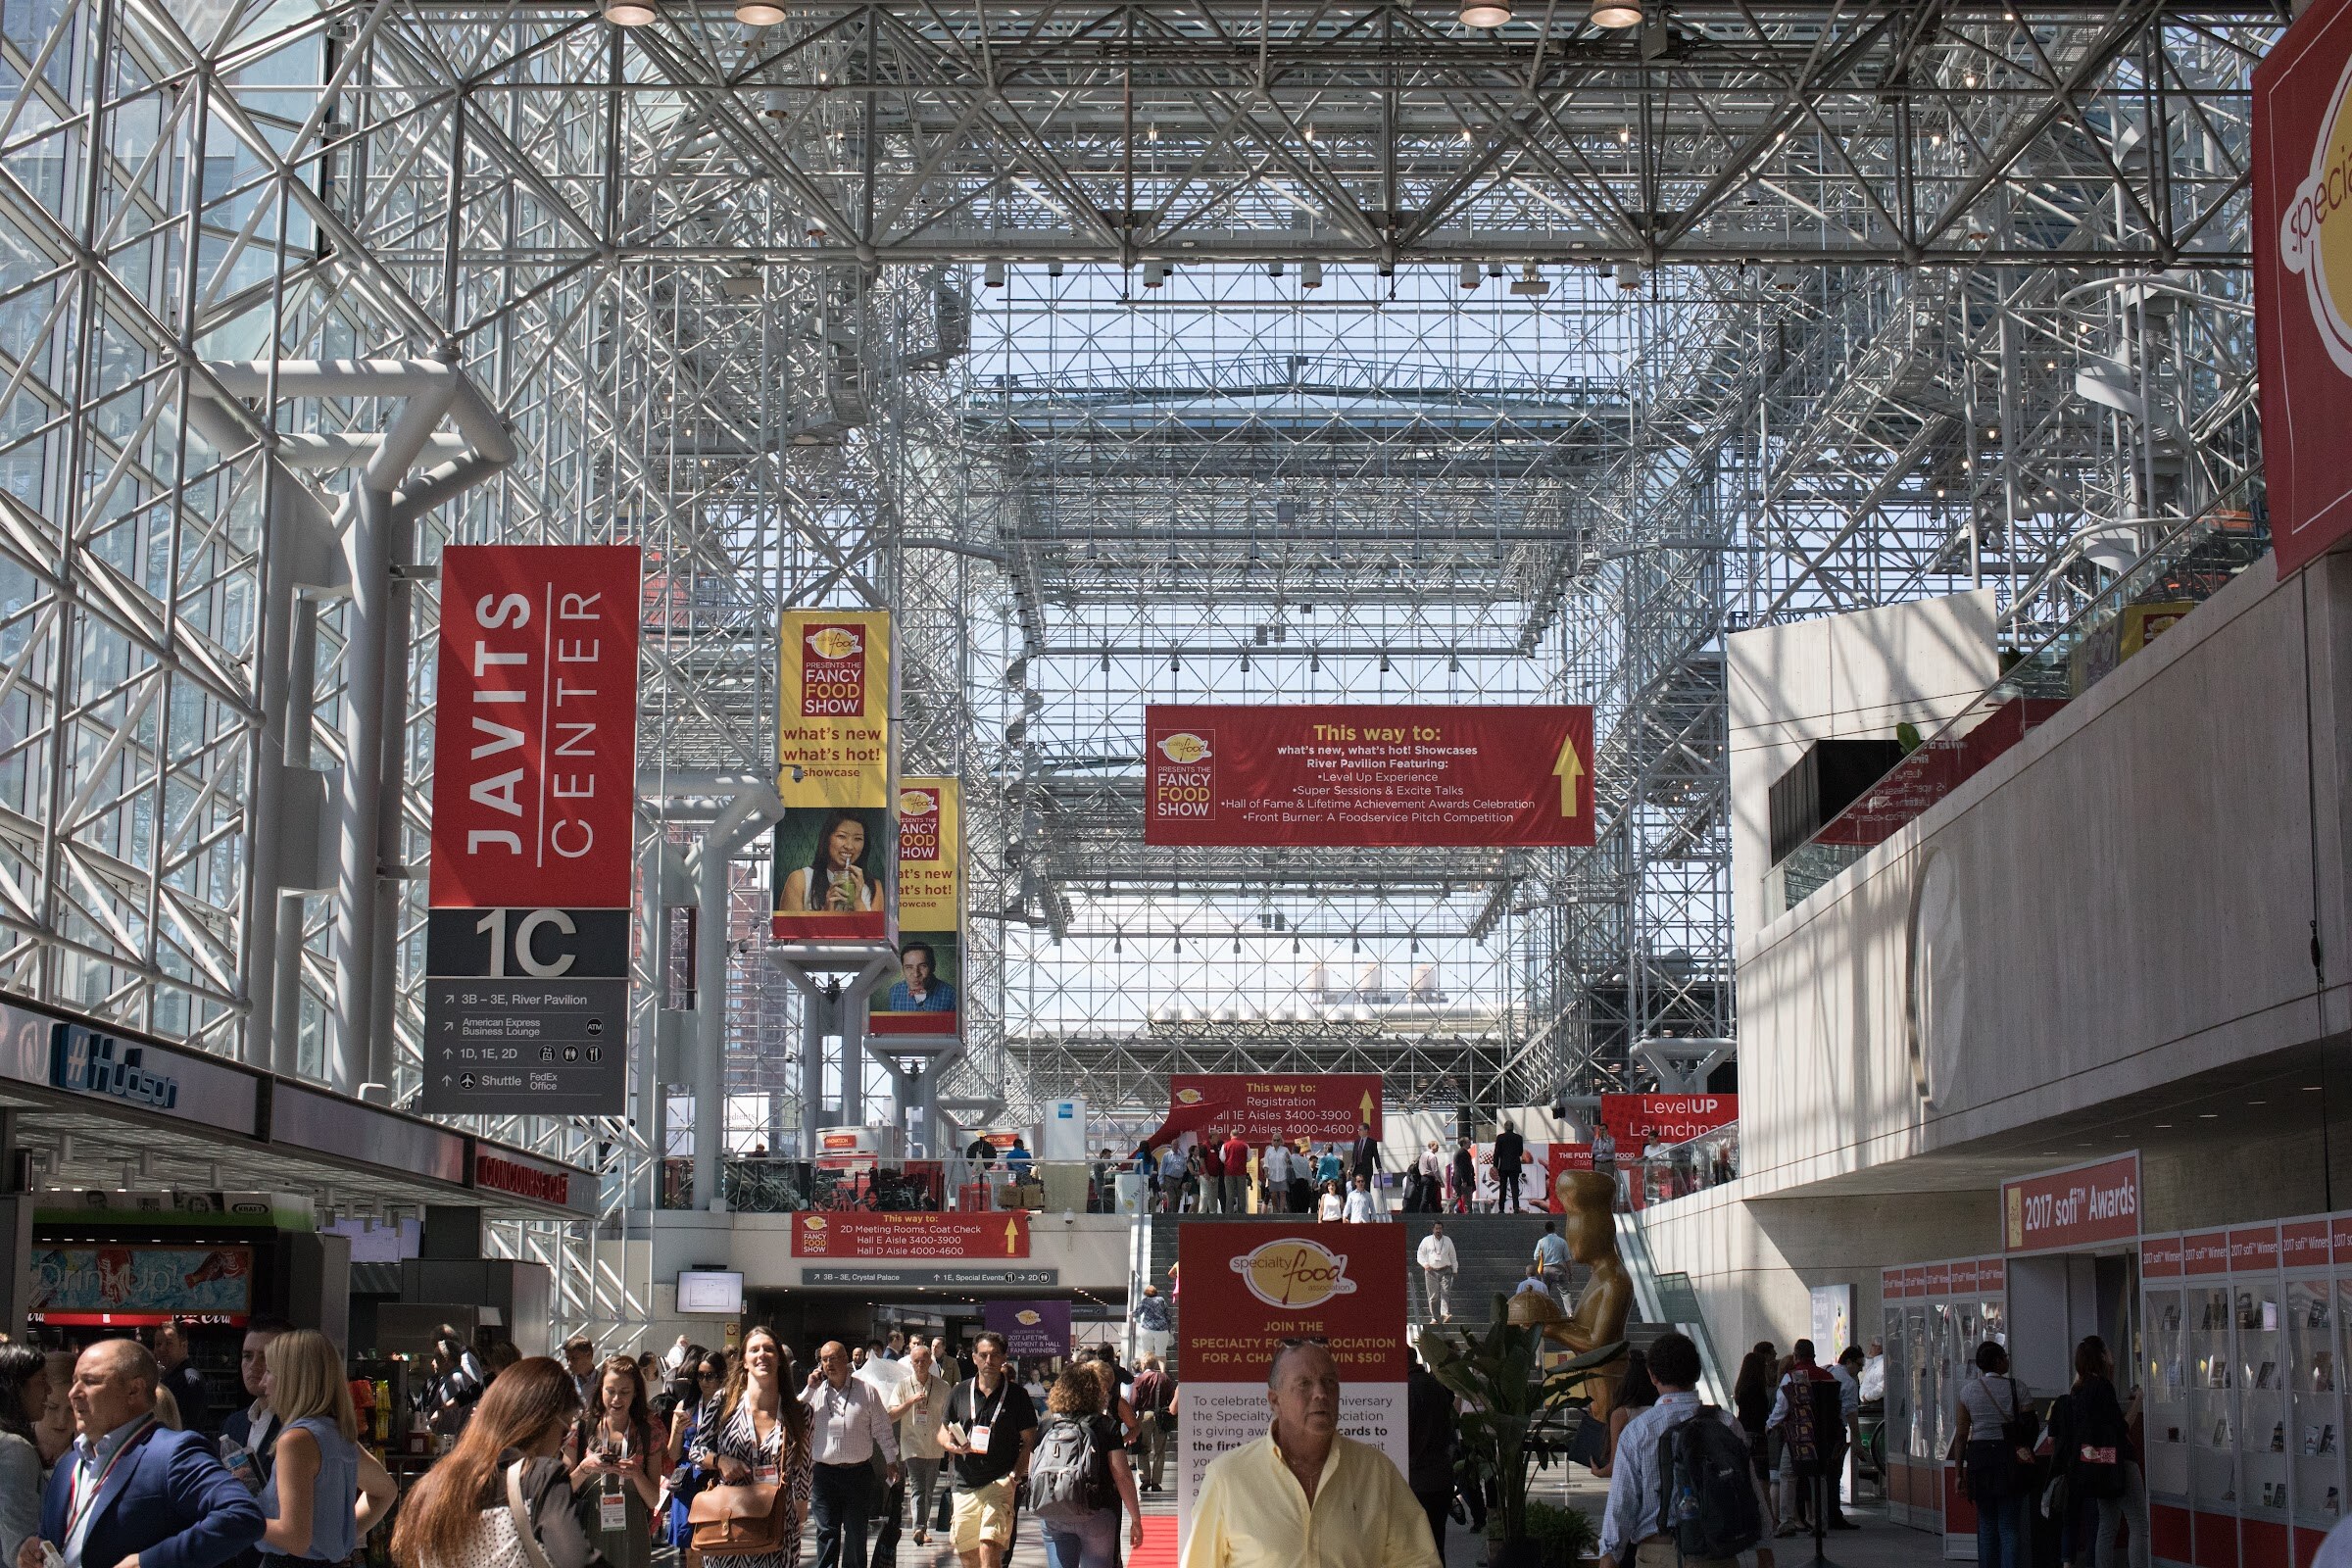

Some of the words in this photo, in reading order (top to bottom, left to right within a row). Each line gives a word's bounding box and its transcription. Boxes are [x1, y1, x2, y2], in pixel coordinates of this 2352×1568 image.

[806, 669, 861, 683] FANCY
[806, 683, 860, 699] FOOD
[805, 699, 858, 713] SHOW
[467, 593, 531, 855] JAVITS
[551, 592, 601, 858] CENTER
[846, 729, 882, 741] new
[1313, 724, 1356, 741] This
[1363, 728, 1406, 745] way
[1412, 726, 1442, 741] to:
[846, 748, 880, 761] hot!
[1318, 747, 1345, 757] new,
[1389, 746, 1411, 755] hot!
[1414, 746, 1478, 755] Showcases
[1306, 759, 1337, 768] River
[1341, 759, 1386, 768] Pavilion
[1390, 759, 1448, 769] Featuring:
[803, 767, 860, 777] showcase
[1356, 773, 1371, 783] Up
[1376, 772, 1439, 783] Experience
[1157, 773, 1211, 786] FANCY
[1157, 787, 1210, 803] FOOD
[1334, 785, 1382, 795] Sessions
[1386, 786, 1394, 795] &
[1397, 786, 1432, 795] Excite
[1435, 786, 1464, 795] Talks
[1249, 799, 1260, 808] of
[1263, 800, 1295, 808] Fame
[1298, 800, 1304, 808] &
[1307, 799, 1351, 808] Lifetime
[1354, 799, 1426, 808] Achievement
[1428, 799, 1470, 808] Awards
[1473, 799, 1535, 808] Celebration
[1157, 803, 1209, 816] SHOW
[1282, 812, 1323, 822] Burner:
[1327, 813, 1335, 822] A
[1339, 812, 1408, 822] Foodservice
[1411, 812, 1440, 822] Pitch
[1443, 812, 1514, 823] Competition
[900, 823, 937, 834] ANCY
[902, 847, 935, 858] HOW
[924, 870, 953, 879] new
[925, 884, 952, 895] hot!
[476, 908, 577, 977] 1C
[462, 994, 477, 1004] 3B
[490, 994, 509, 1006] 3E,
[512, 994, 541, 1004] River
[544, 994, 588, 1005] Pavilion
[463, 1018, 504, 1027] American
[506, 1018, 541, 1029] Express
[588, 1022, 603, 1031] ATM
[462, 1027, 503, 1036] Business
[507, 1027, 540, 1037] Lounge
[461, 1049, 477, 1059] 1D,
[481, 1049, 498, 1059] 1E,
[501, 1048, 517, 1058] 2D
[92, 1035, 178, 1108] Hudson
[529, 1072, 558, 1082] FedEx
[481, 1075, 521, 1086] Shuttle
[529, 1081, 558, 1091] Office
[1246, 1083, 1271, 1093] This
[1274, 1086, 1297, 1096] way
[1299, 1084, 1316, 1093] to:
[1247, 1097, 1316, 1108] Registration
[1643, 1099, 1718, 1114] LevelUP
[1213, 1110, 1231, 1120] all
[1232, 1111, 1245, 1120] 1E
[1248, 1110, 1282, 1120] Aisles
[1285, 1110, 1351, 1120] 3400-3900
[1208, 1124, 1231, 1134] Hall
[1233, 1124, 1247, 1134] 1D
[1249, 1124, 1283, 1134] Aisles
[1286, 1124, 1354, 1135] 4000-4600
[484, 1156, 546, 1198] CONCOURSE
[238, 1204, 265, 1213] KRAFT
[2026, 1194, 2052, 1231] 2017
[2088, 1176, 2135, 1221] Awards
[883, 1214, 901, 1223] This
[903, 1216, 923, 1225] way
[855, 1225, 891, 1236] Meeting
[894, 1226, 927, 1235] Rooms,
[953, 1225, 981, 1234] Check
[857, 1236, 874, 1245] Hall
[885, 1236, 907, 1245] Aisle
[909, 1236, 961, 1245] 3400-3900
[2282, 1240, 2295, 1252] 2017
[857, 1247, 874, 1255] Hall
[886, 1247, 907, 1255] Aisle
[910, 1247, 964, 1255] 4000-4600
[2185, 1249, 2195, 1261] 2017
[2230, 1245, 2243, 1257] 2017
[2143, 1252, 2153, 1264] 2017
[852, 1274, 873, 1283] Crystal
[956, 1274, 980, 1283] Special
[1233, 1256, 1294, 1269] specialty
[1282, 1249, 1345, 1305] food
[1264, 1322, 1295, 1332] JOIN
[1298, 1322, 1323, 1332] THE
[1192, 1338, 1261, 1348] SPECIALTY
[1201, 1352, 1229, 1363] FOR
[1233, 1352, 1242, 1363] A
[1246, 1352, 1273, 1363] CHA
[1357, 1351, 1386, 1364] $50!
[1193, 1396, 1207, 1406] To
[1210, 1396, 1268, 1406] celebrate
[1339, 1396, 1393, 1408] niversary
[1193, 1411, 1212, 1421] the
[1216, 1410, 1272, 1424] Specialty
[1193, 1426, 1202, 1437] is
[1205, 1426, 1244, 1439] giving
[1338, 1425, 1371, 1437] cards
[1374, 1426, 1388, 1437] to
[1193, 1441, 1213, 1451] the
[1217, 1441, 1242, 1451] first
